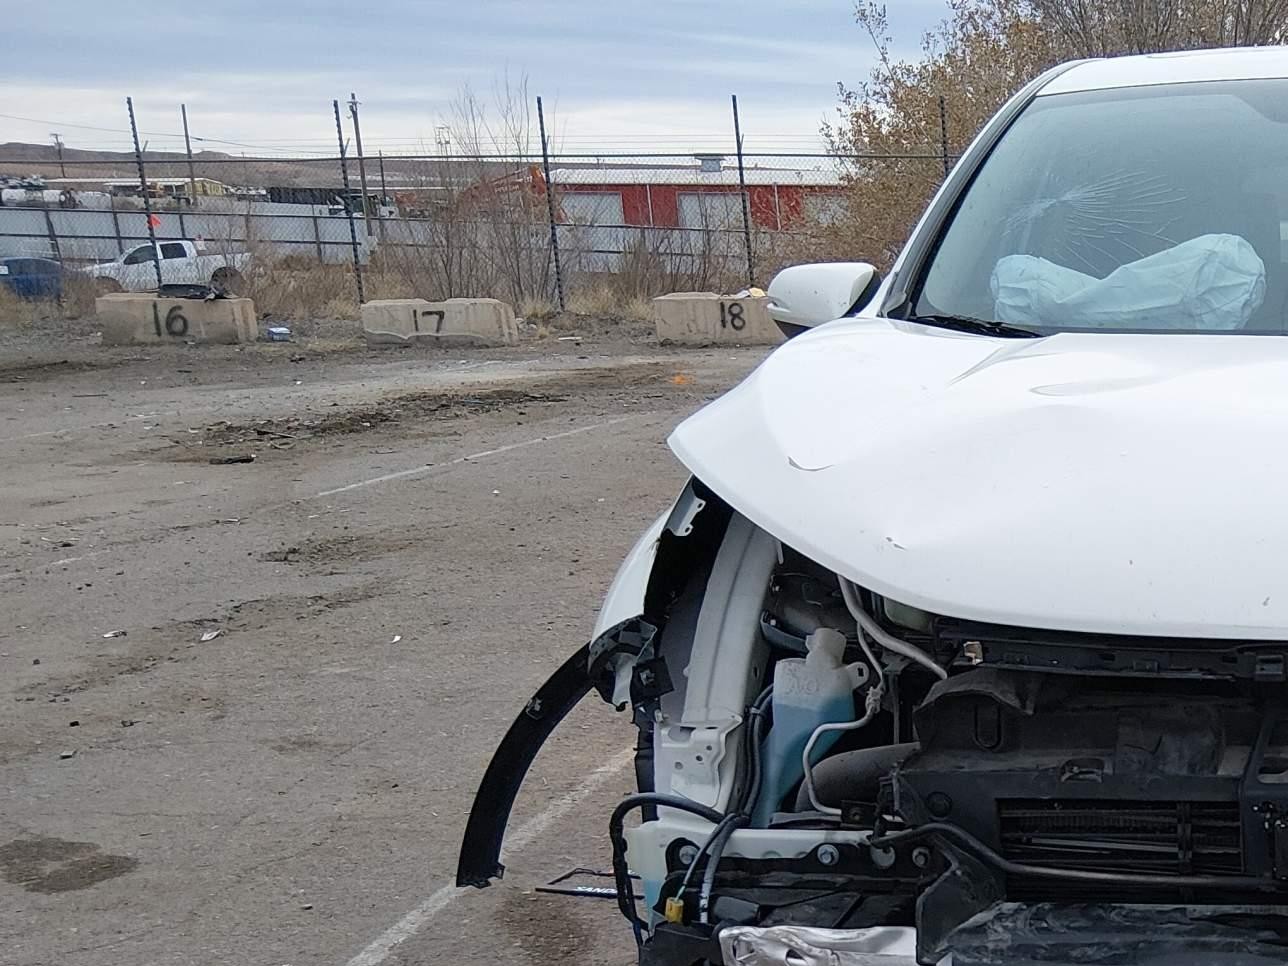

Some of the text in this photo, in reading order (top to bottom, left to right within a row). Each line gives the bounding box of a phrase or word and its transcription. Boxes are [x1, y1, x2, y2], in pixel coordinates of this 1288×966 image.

[152, 302, 188, 337] 16
[412, 309, 445, 340] 17
[720, 301, 746, 331] 18
